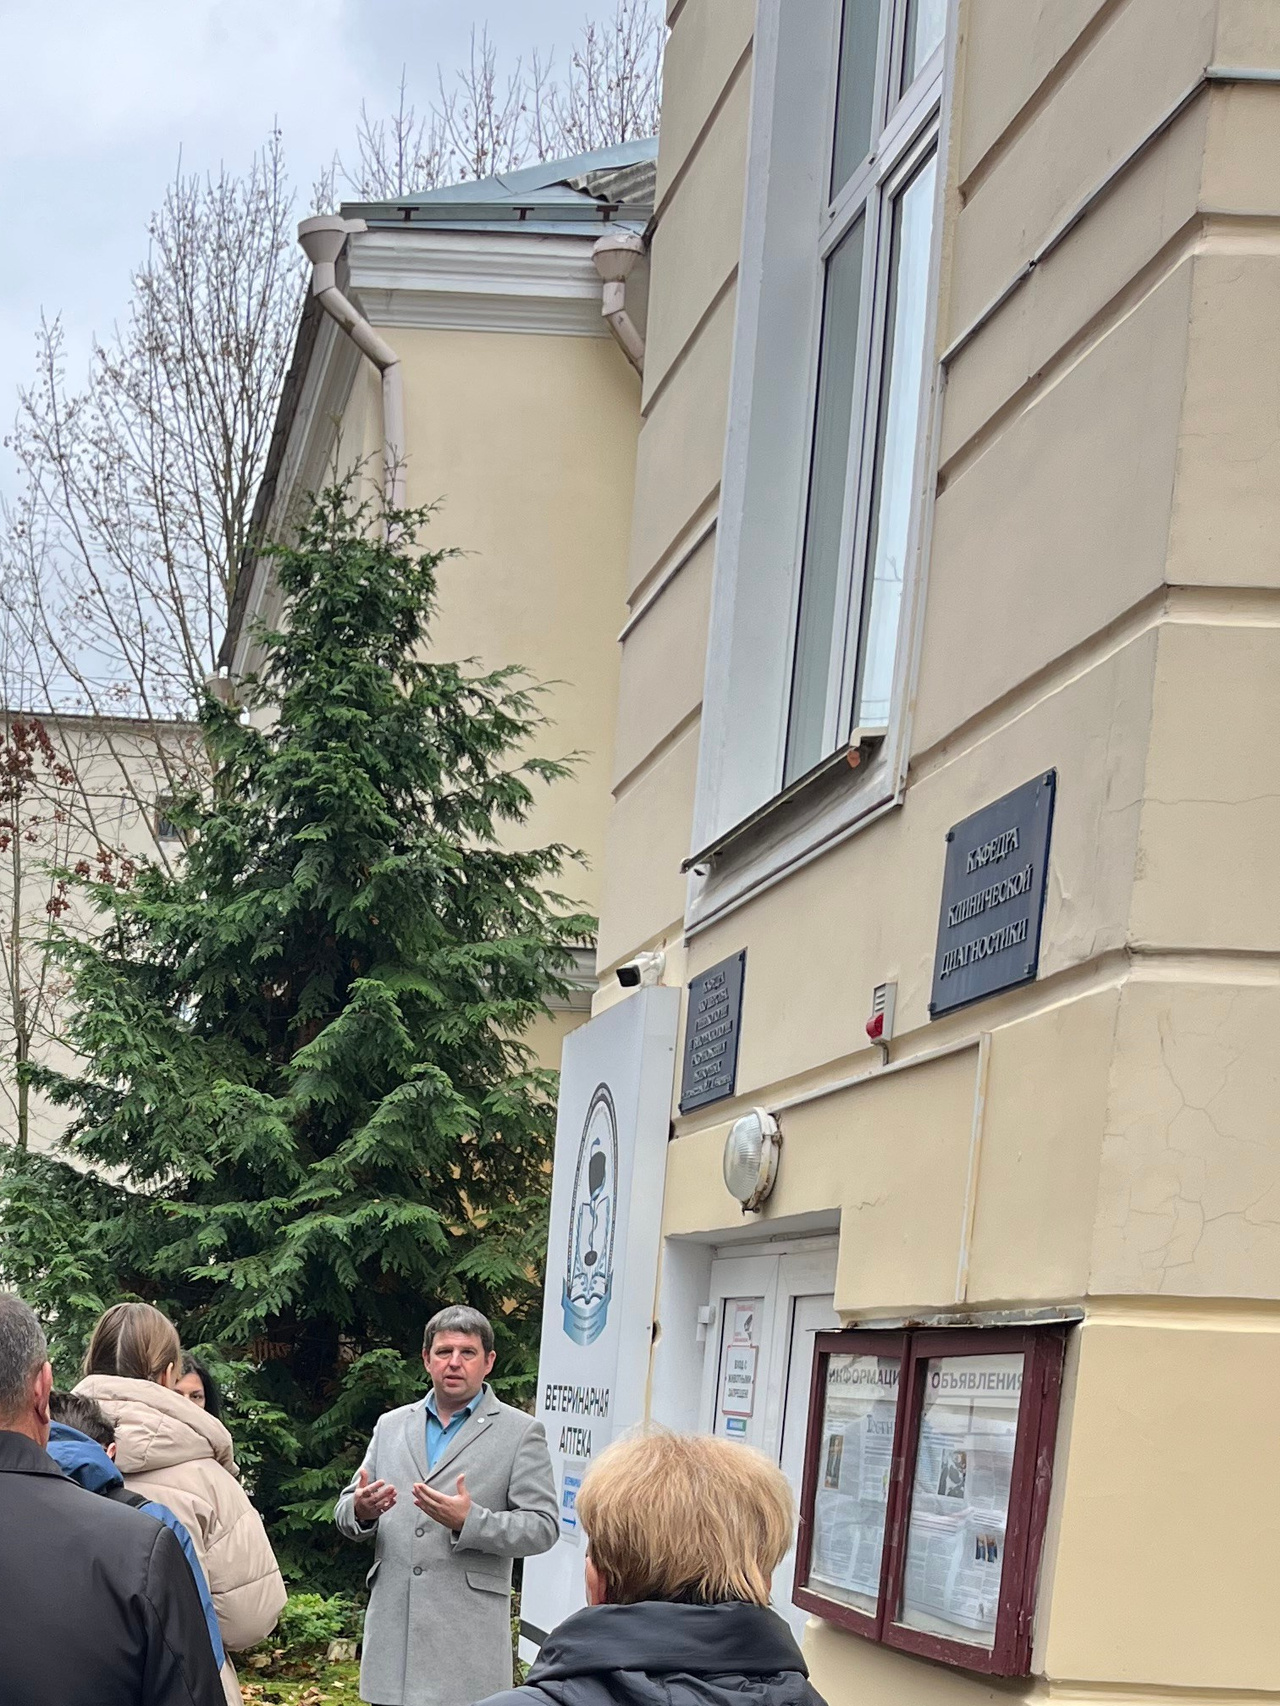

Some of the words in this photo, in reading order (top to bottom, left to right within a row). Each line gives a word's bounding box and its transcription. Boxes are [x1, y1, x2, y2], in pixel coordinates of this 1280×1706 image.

[967, 827, 1019, 873] КАФЕДРА
[947, 864, 1033, 928] КЛИНИЧЕСКОЙ
[940, 918, 1028, 980] ДИАГНОСТИКИ
[545, 1384, 610, 1417] ВЕТЕРИНАРНАЯ
[559, 1426, 592, 1458] АПТЕКА
